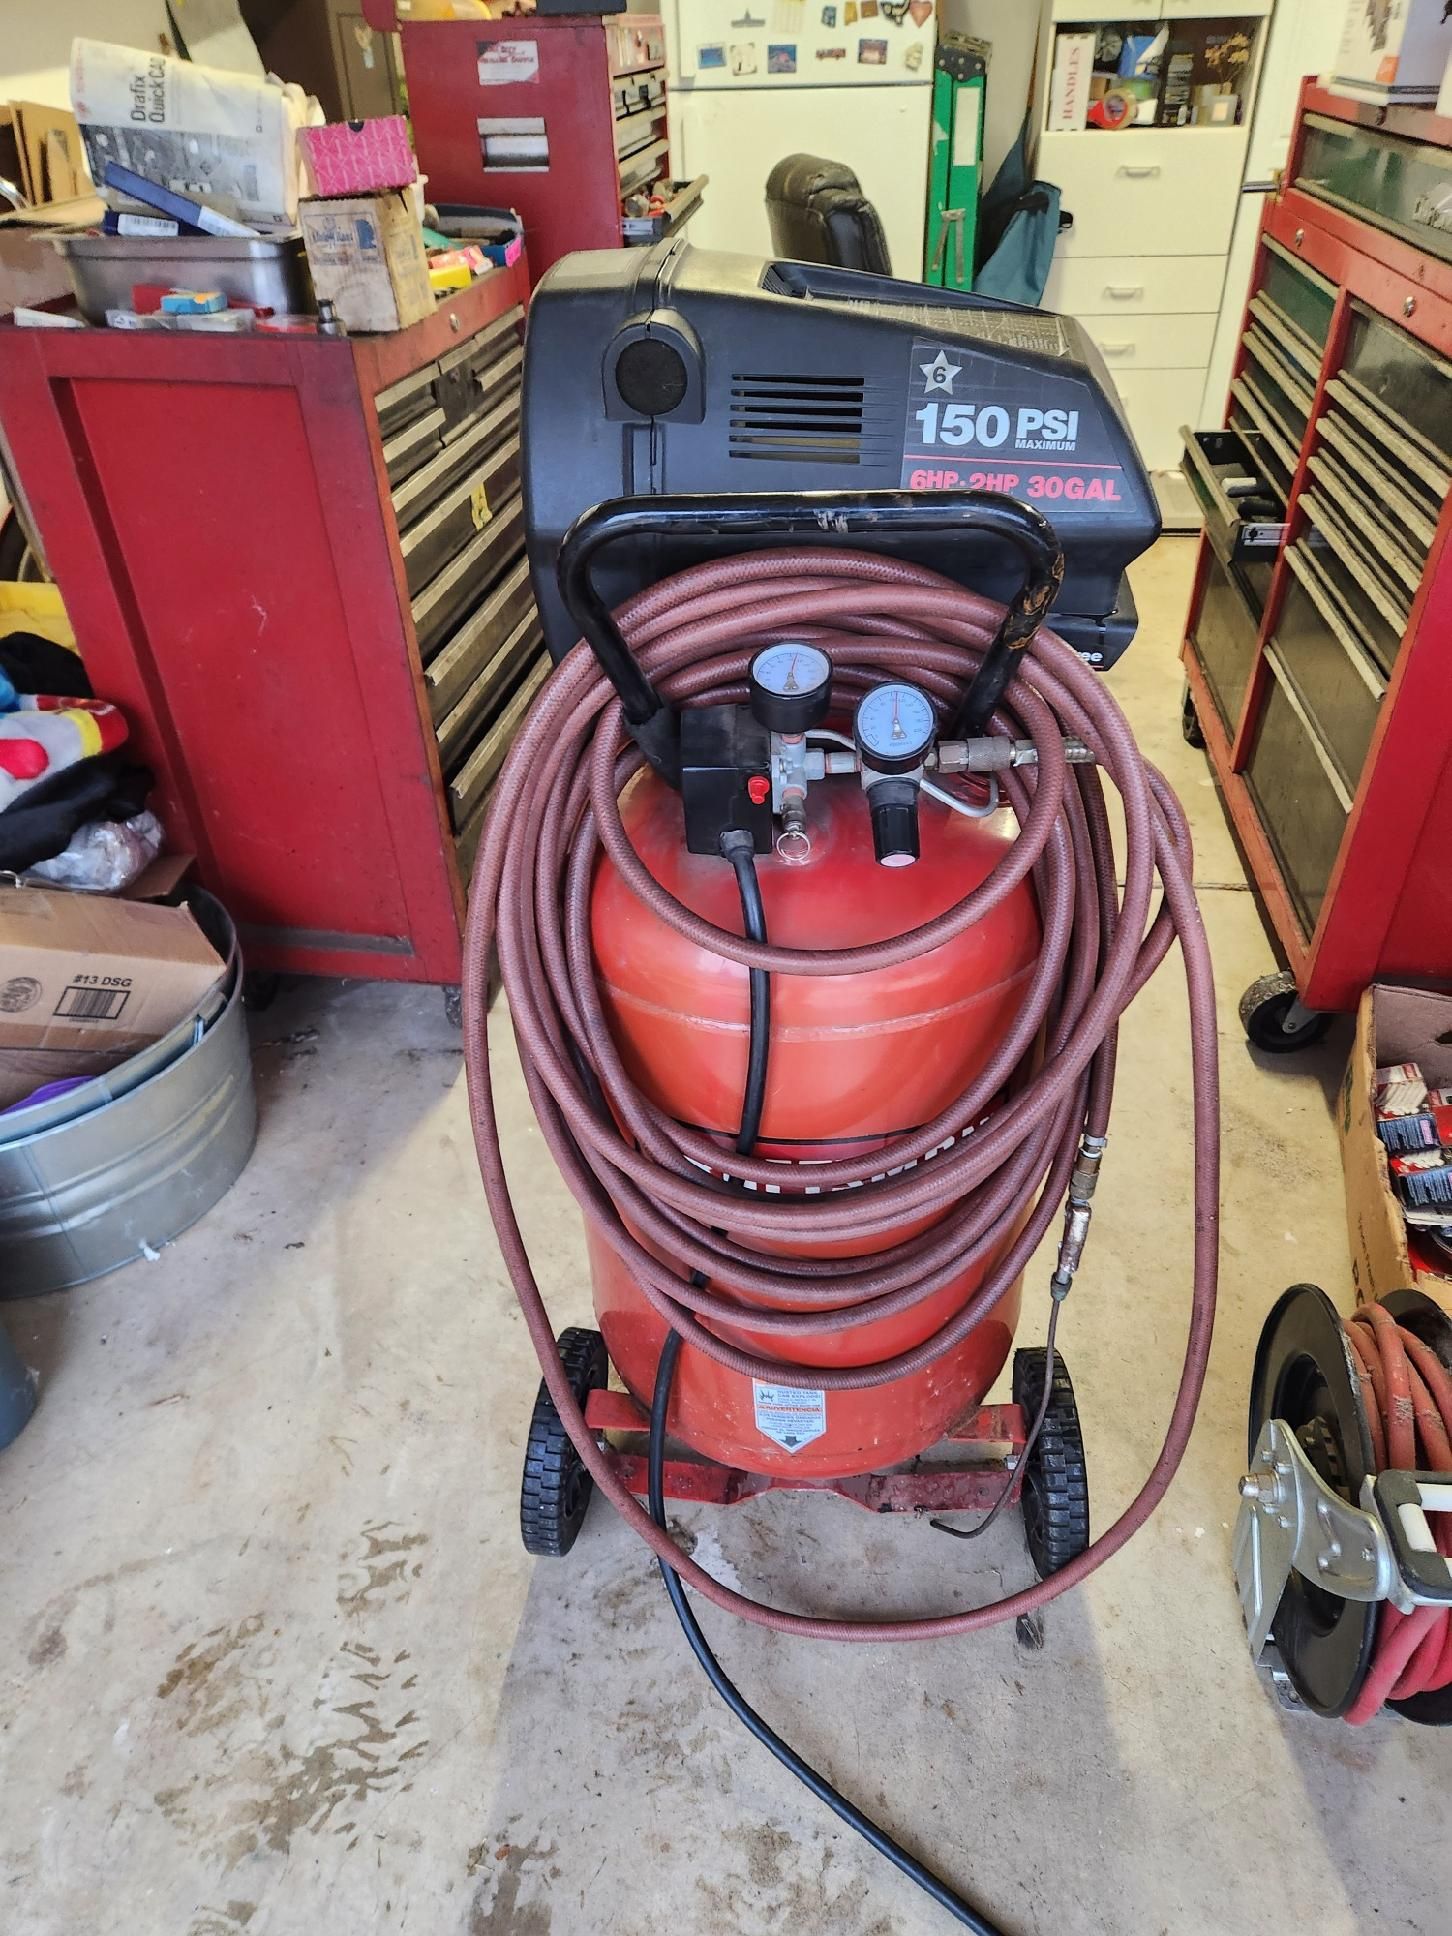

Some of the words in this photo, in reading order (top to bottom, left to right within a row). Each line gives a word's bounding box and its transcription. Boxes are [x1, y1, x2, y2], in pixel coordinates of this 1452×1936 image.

[130, 75, 146, 122] Drafix
[1062, 47, 1079, 119] HANDLES
[148, 80, 165, 123] Quick
[932, 366, 947, 384] 6
[915, 402, 1011, 448] 150
[1015, 408, 1079, 441] PSI
[1015, 438, 1076, 451] MAXIMUM
[1027, 475, 1121, 501] 30GAL
[73, 974, 98, 985] #13
[101, 976, 134, 987] DSG
